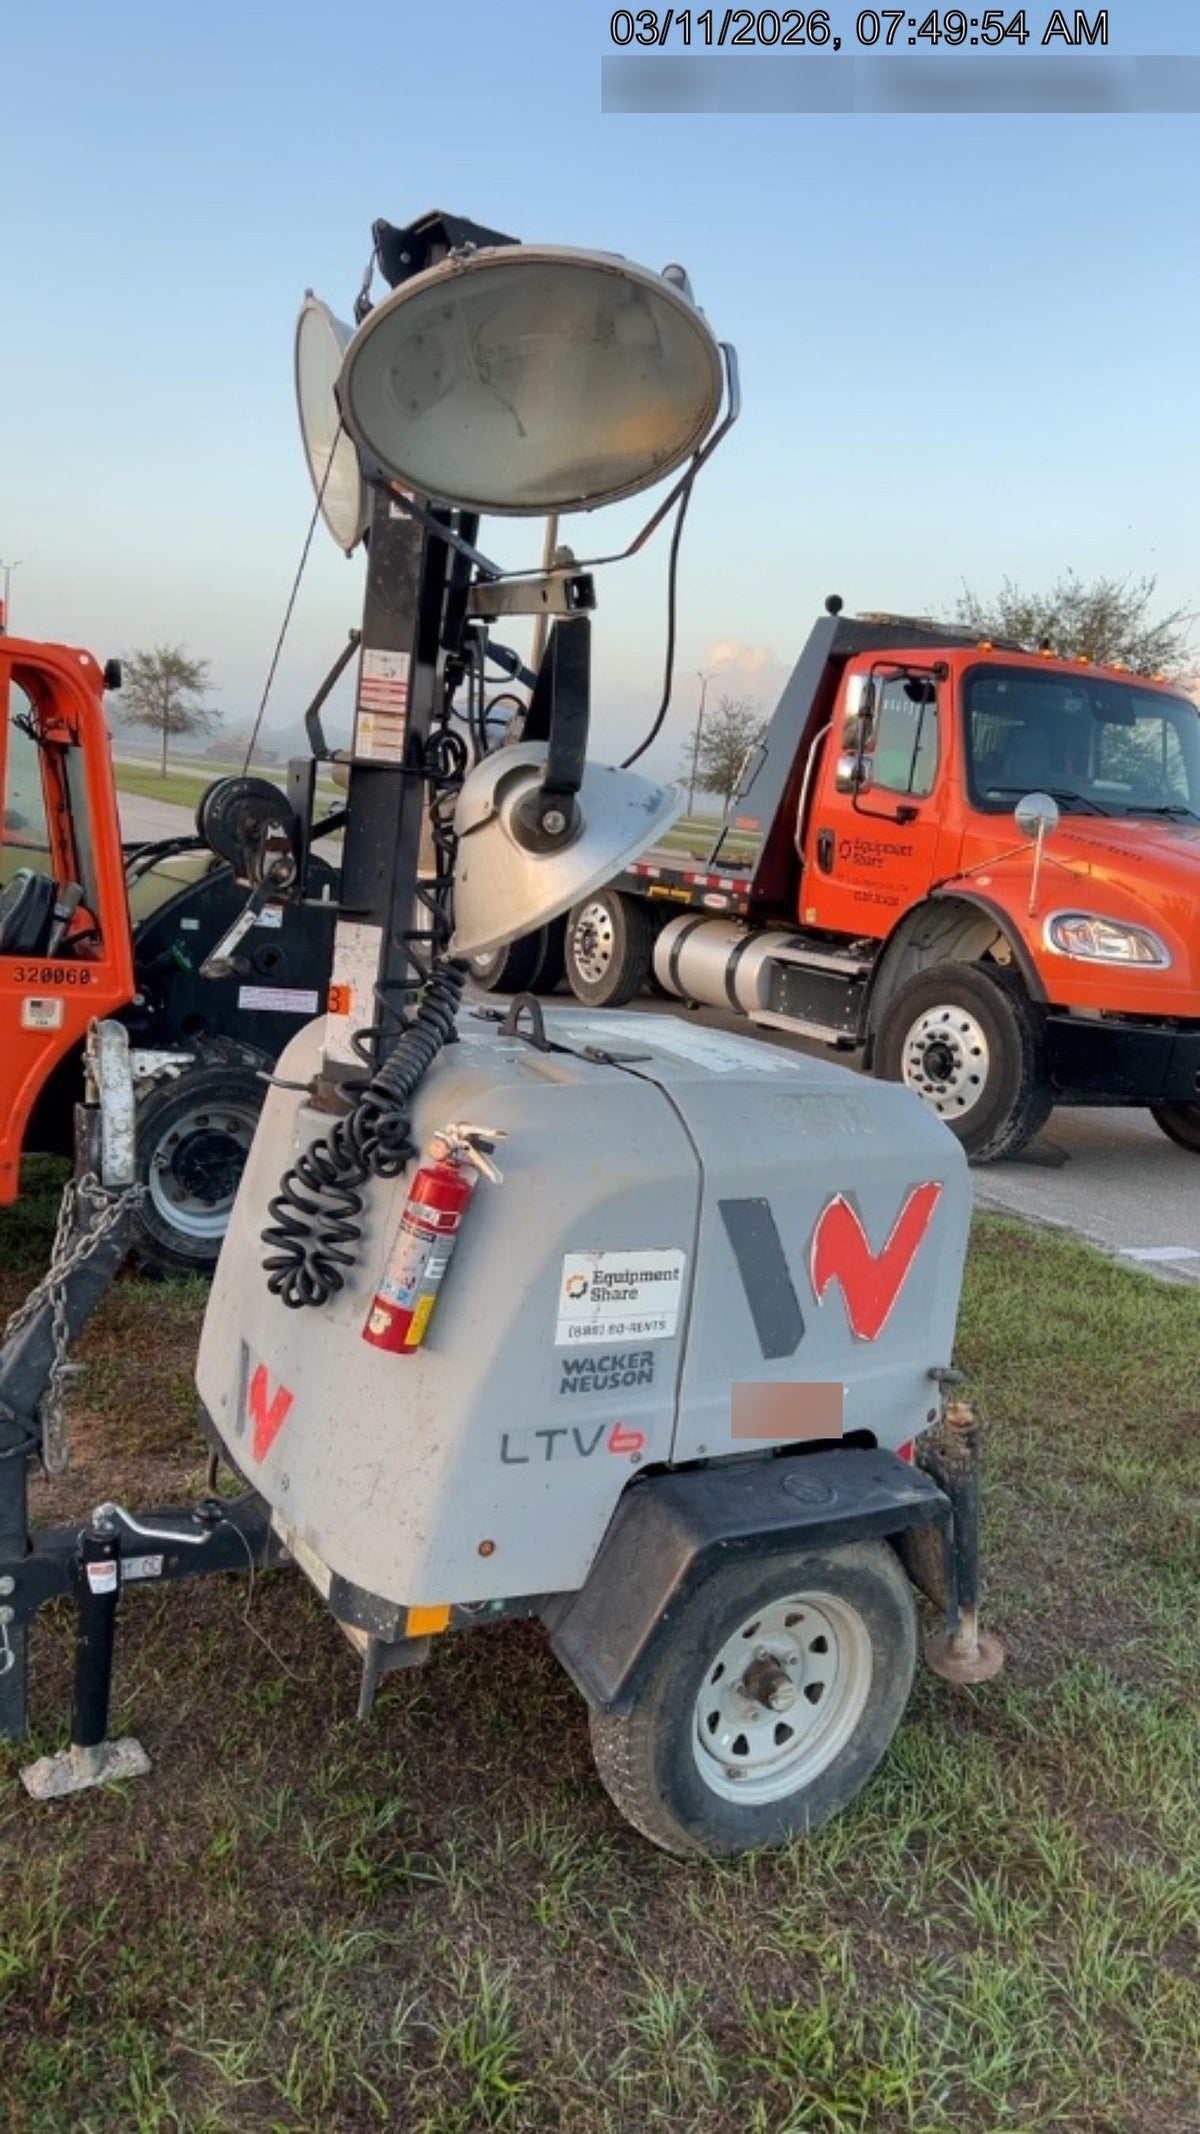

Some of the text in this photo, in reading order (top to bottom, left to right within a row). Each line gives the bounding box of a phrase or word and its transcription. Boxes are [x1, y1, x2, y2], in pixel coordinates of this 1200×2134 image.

[591, 1268, 680, 1287] Equipment
[590, 1287, 639, 1302] Share
[562, 1351, 655, 1376] WACKER
[559, 1368, 654, 1395] NEUSON
